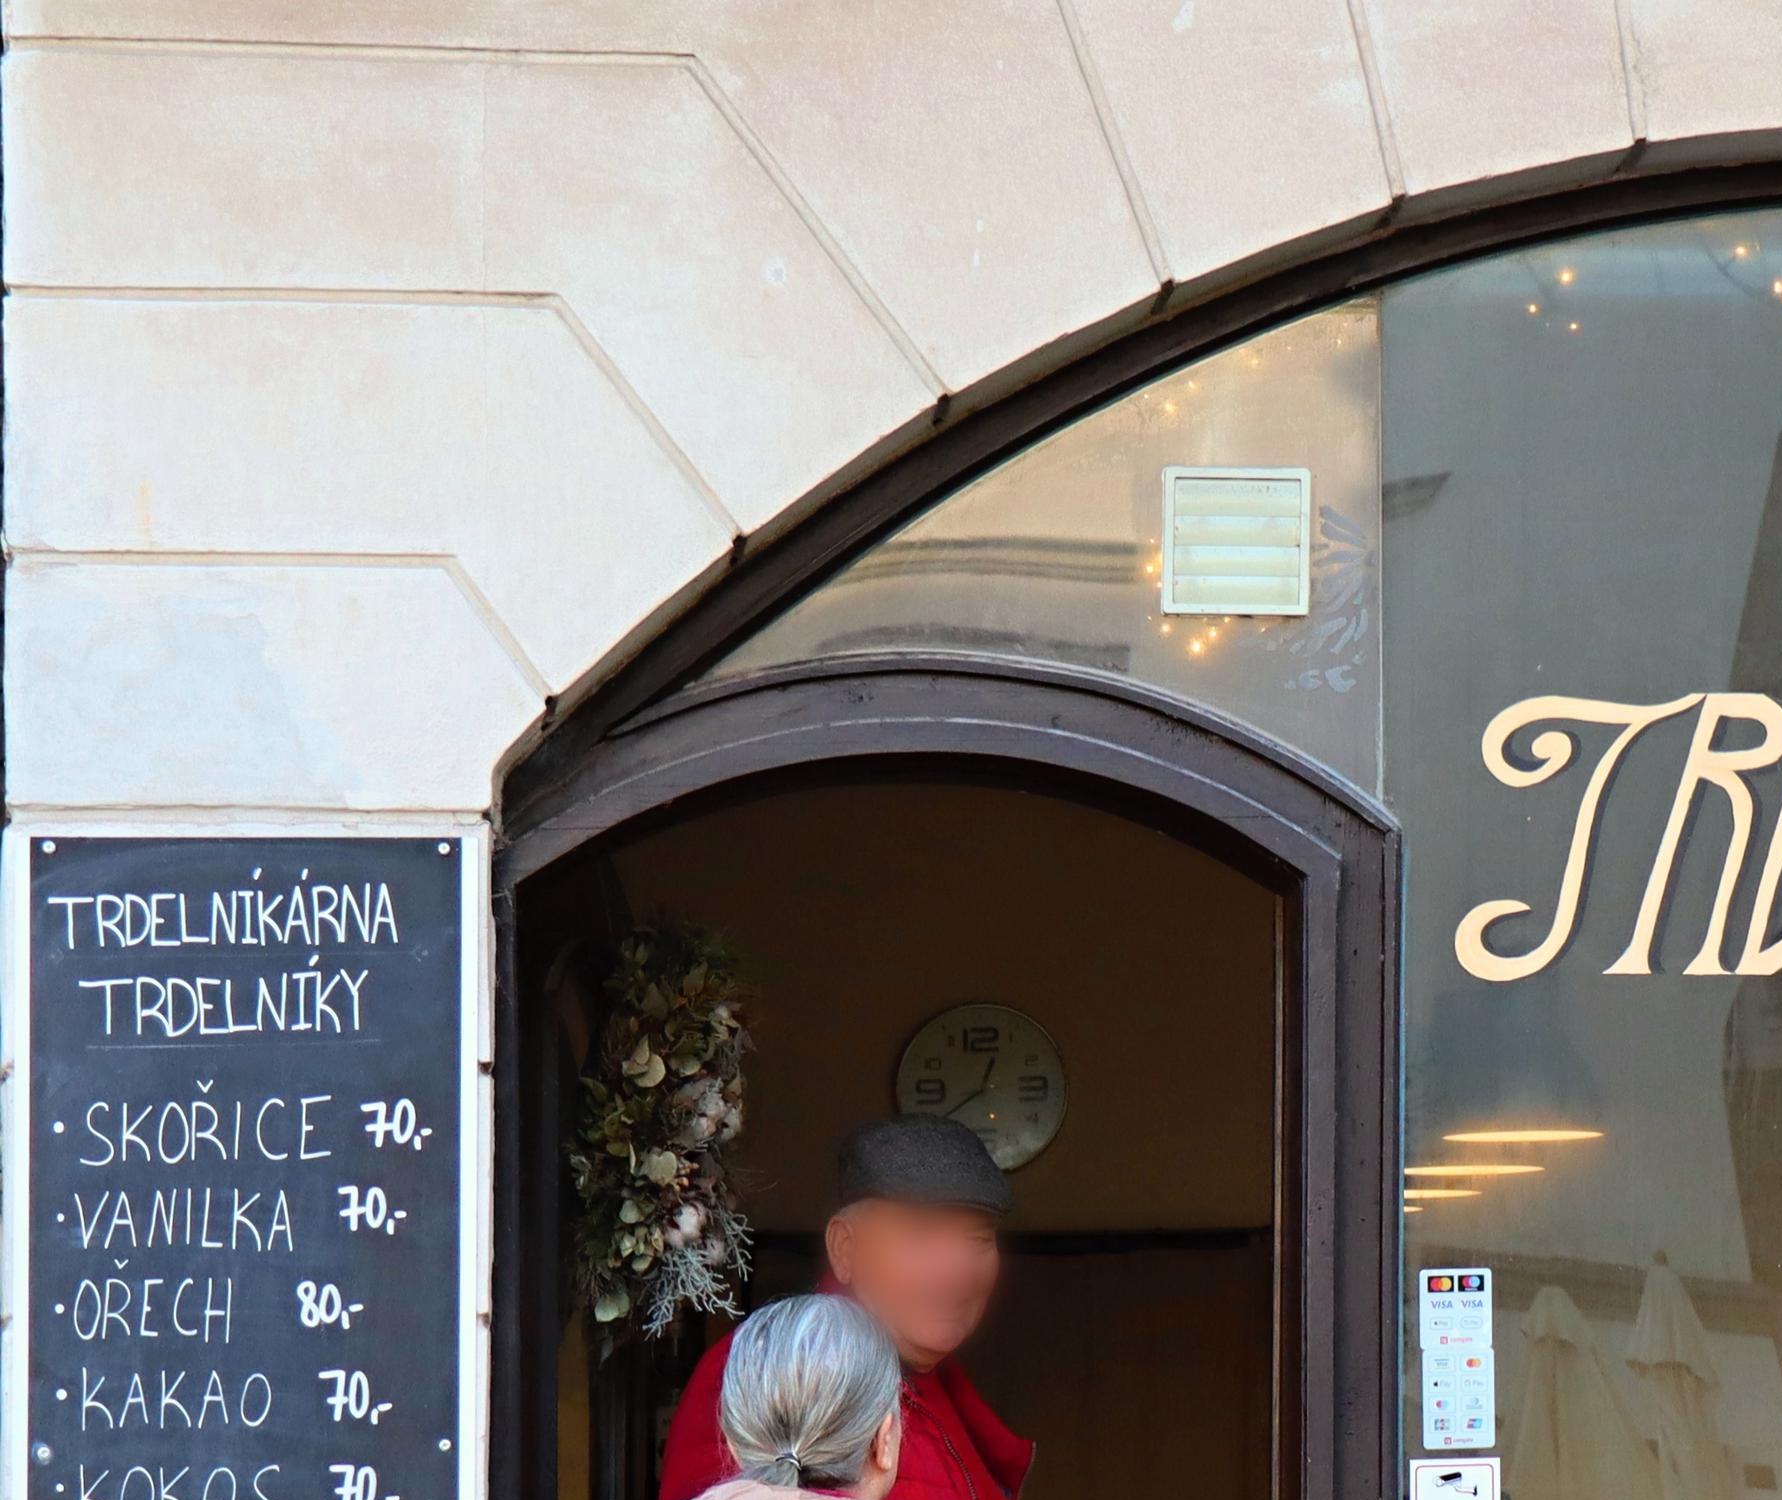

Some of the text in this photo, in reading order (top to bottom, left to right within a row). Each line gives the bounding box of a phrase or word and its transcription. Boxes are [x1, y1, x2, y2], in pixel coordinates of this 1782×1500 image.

[46, 867, 399, 950] TRDELNÍKÁRNA
[78, 954, 369, 1038] TRDELNÍKY
[963, 1026, 999, 1052] 12
[916, 1078, 945, 1104] 9
[1018, 1076, 1048, 1101] 3
[79, 1079, 433, 1167] SKOŘICE 70,-
[73, 1185, 408, 1252] VANILKA 70,-
[73, 1258, 364, 1344] OŘECH 80,-
[1430, 1299, 1483, 1309] VISA VISA
[81, 1366, 393, 1432] KAKAO 70,-
